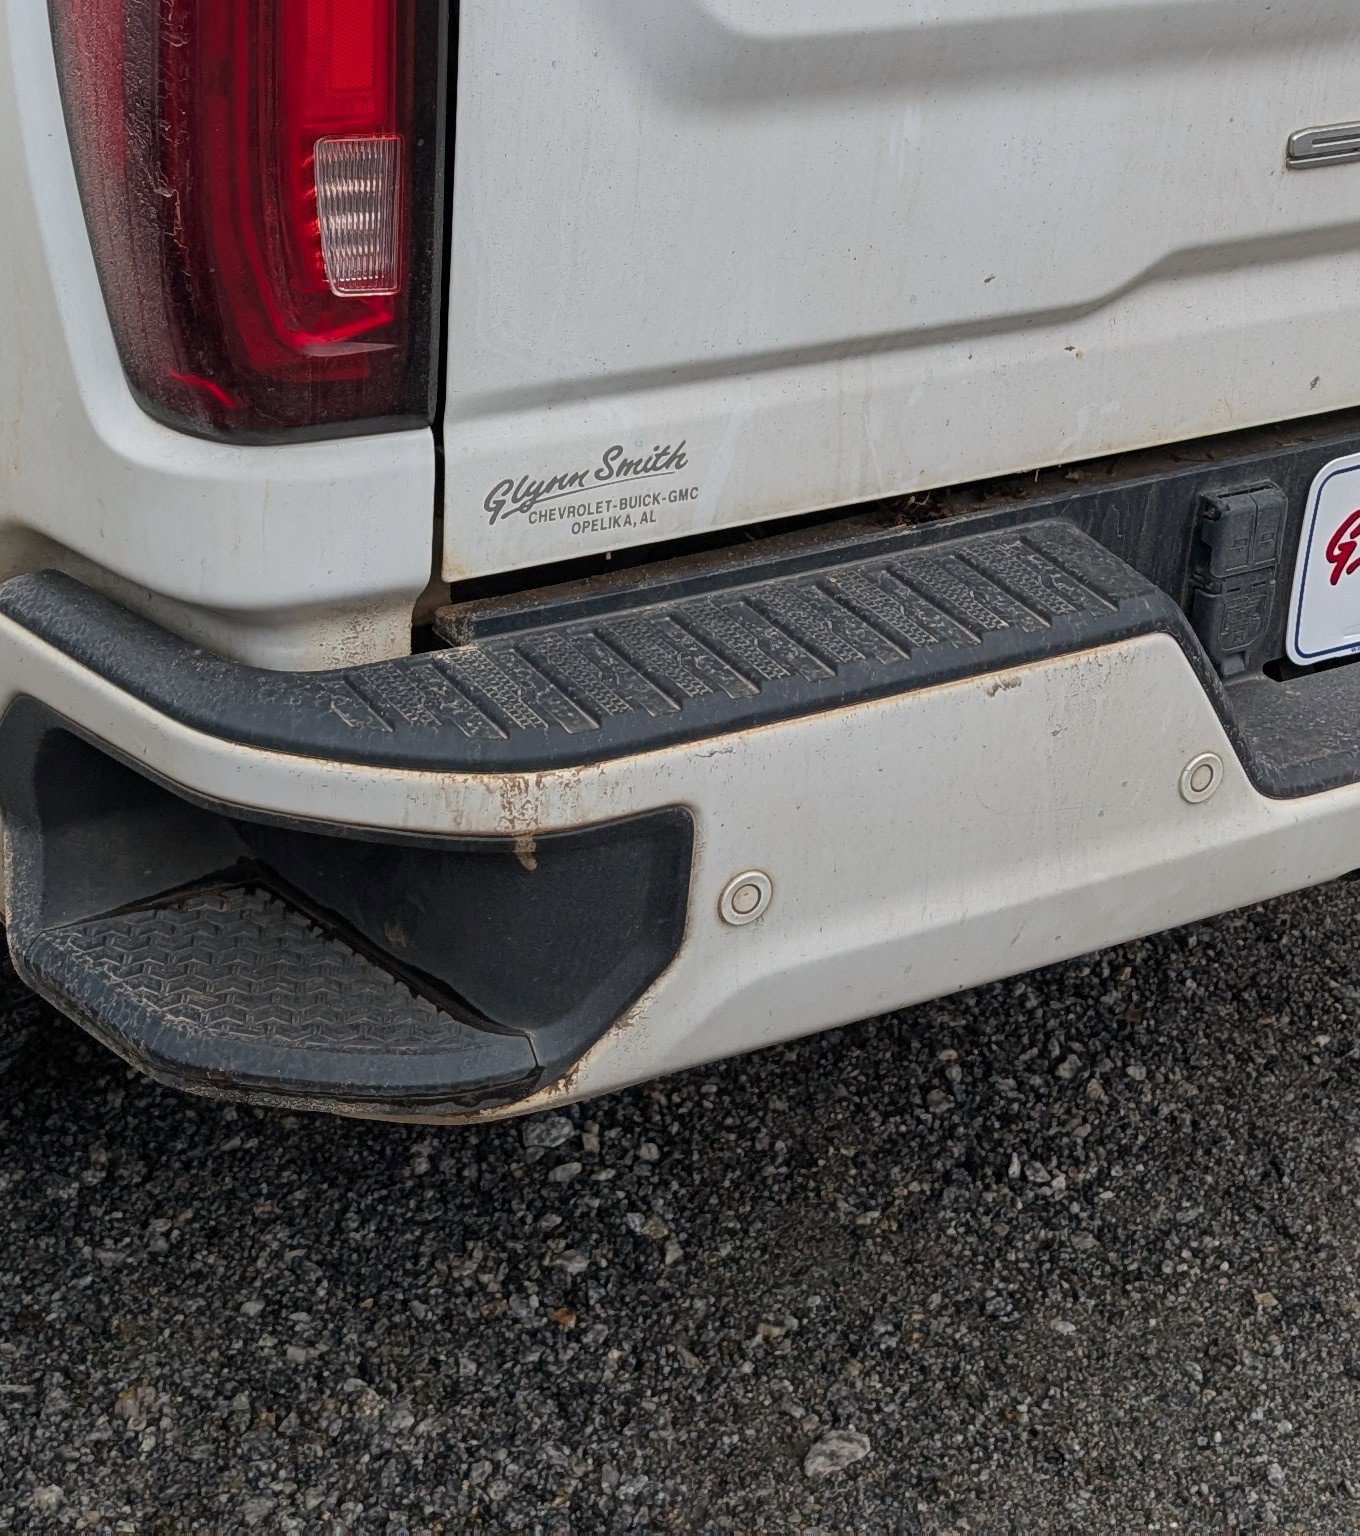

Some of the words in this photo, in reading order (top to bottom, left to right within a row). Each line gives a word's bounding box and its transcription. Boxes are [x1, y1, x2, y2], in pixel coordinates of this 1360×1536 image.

[483, 469, 590, 526] Glynn
[594, 440, 689, 481] Smith
[528, 486, 699, 525] CHEVROLET-BUICK-GMC
[571, 515, 637, 535] OPELIKA,
[640, 510, 657, 525] AL
